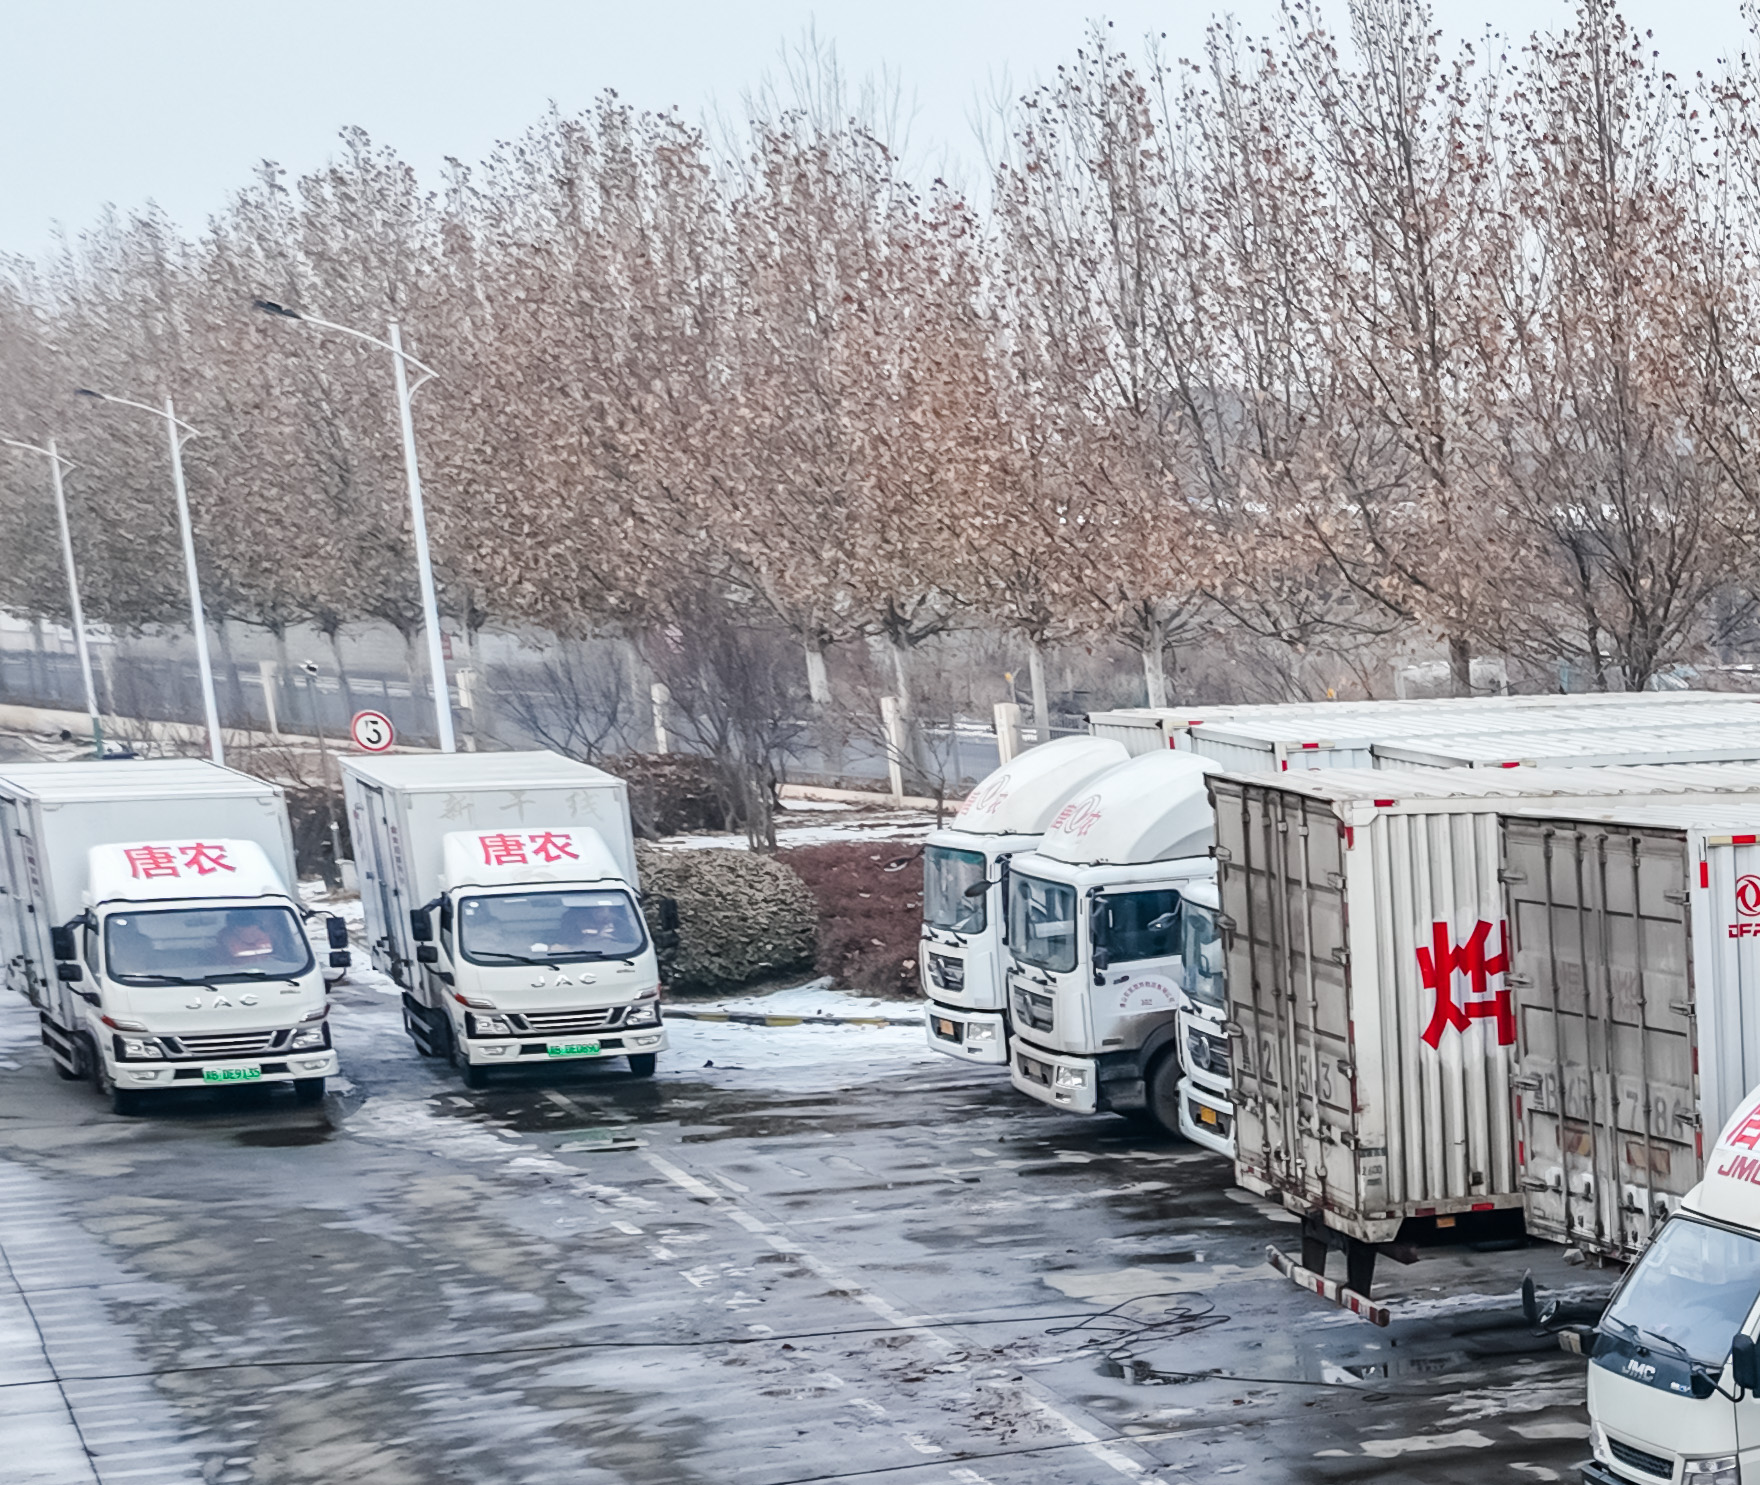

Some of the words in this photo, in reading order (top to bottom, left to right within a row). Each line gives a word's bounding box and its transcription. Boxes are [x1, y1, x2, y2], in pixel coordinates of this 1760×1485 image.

[365, 720, 382, 744] 5
[124, 842, 236, 879] 唐农
[480, 832, 580, 866] 唐农
[531, 973, 597, 988] JAC
[186, 994, 260, 1010] JAC
[1622, 1359, 1656, 1382] JMC
